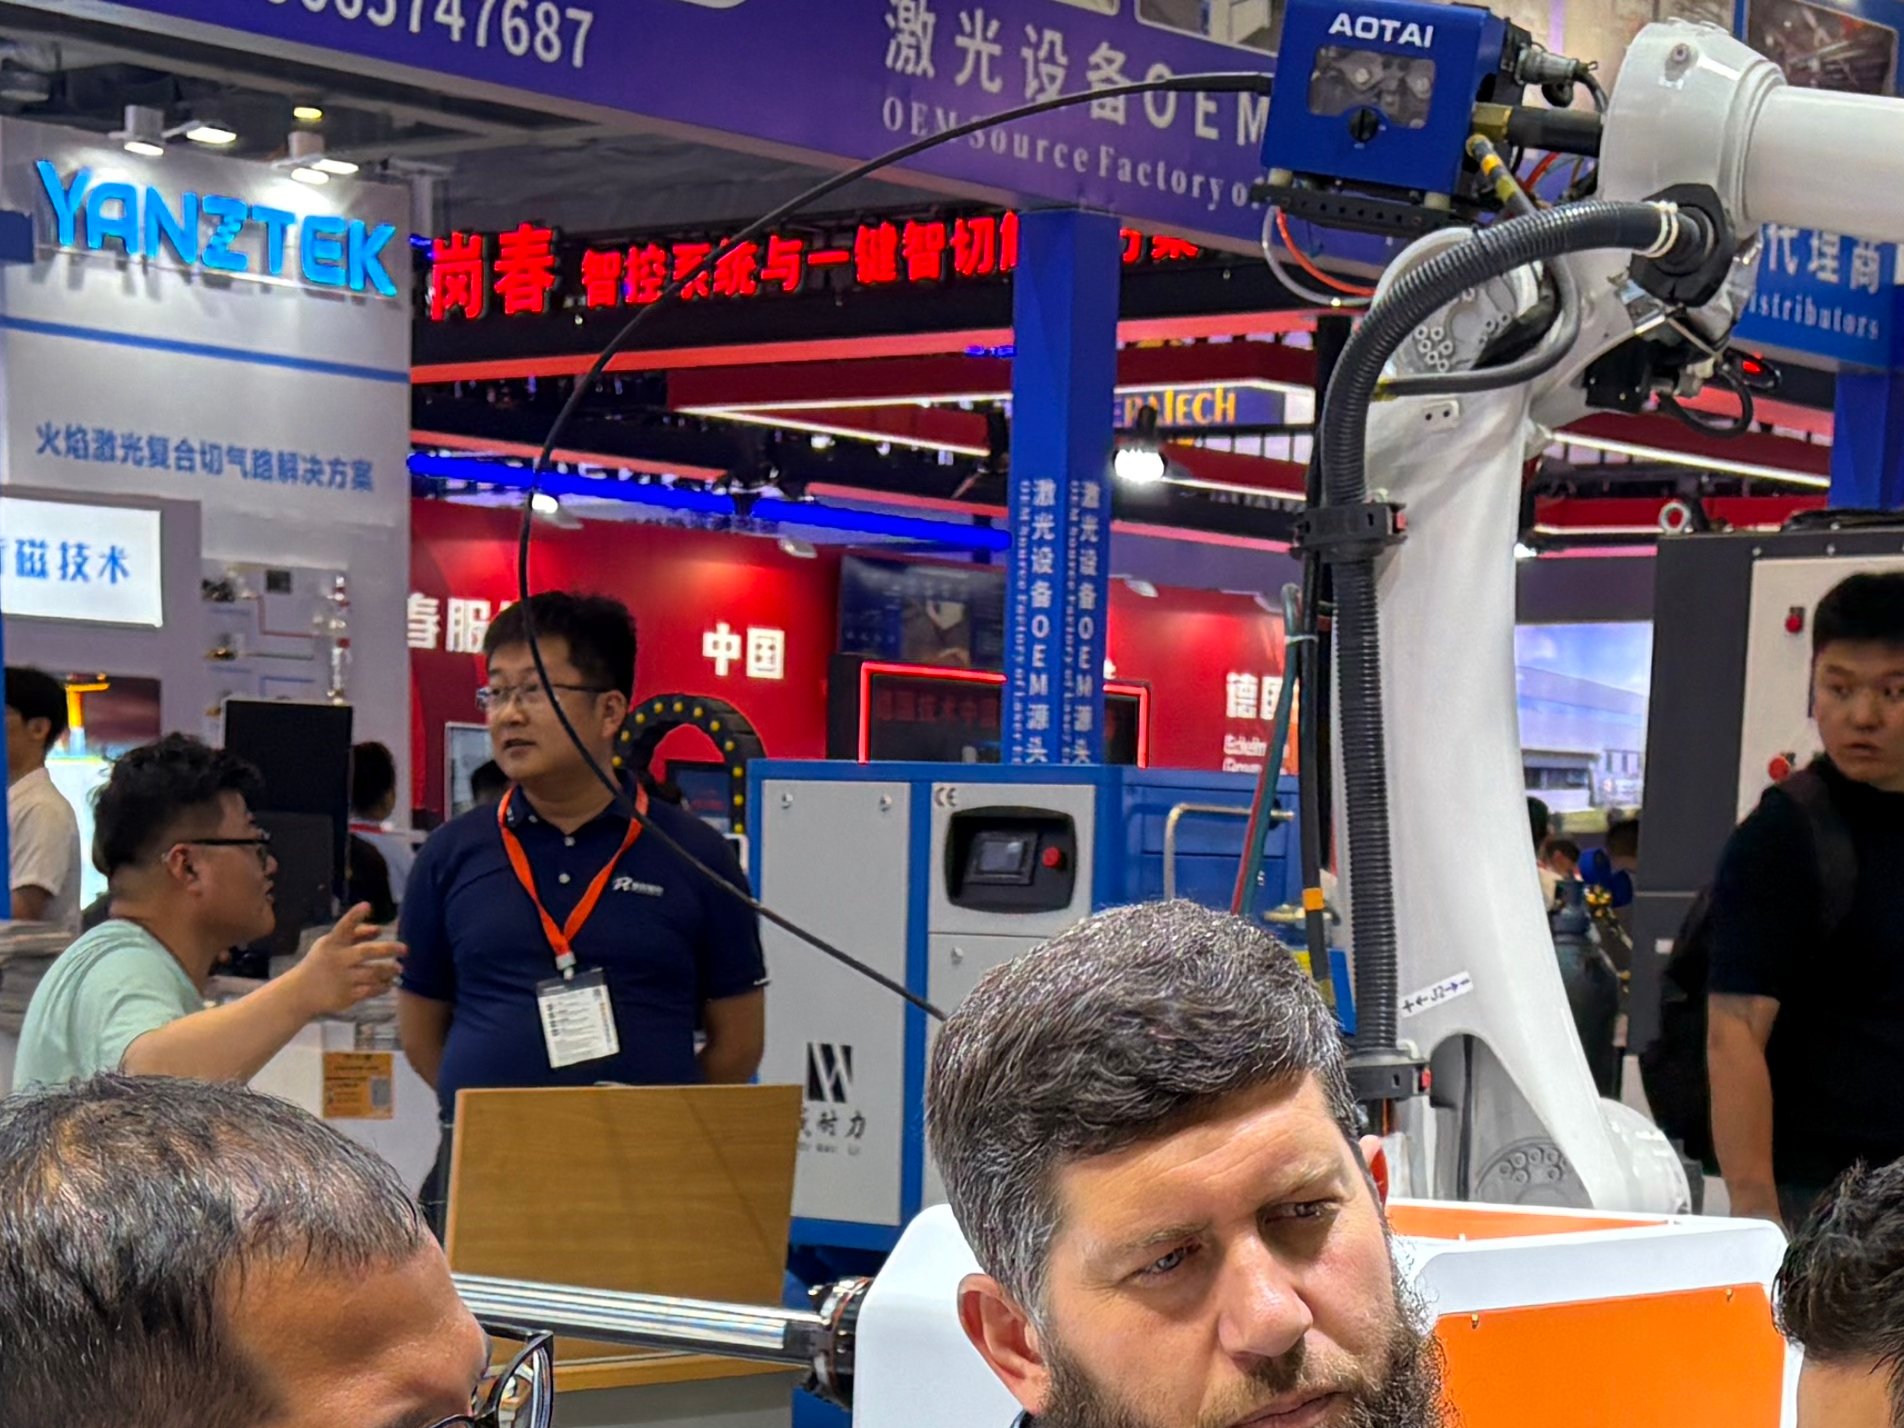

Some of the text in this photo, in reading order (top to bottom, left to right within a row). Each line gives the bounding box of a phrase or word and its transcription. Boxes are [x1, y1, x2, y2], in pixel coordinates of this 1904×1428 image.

[1328, 14, 1434, 48] AOTAI
[968, 115, 1089, 174] Source
[1098, 145, 1225, 211] Factory
[35, 160, 397, 297] YANZTEK
[702, 622, 785, 680] 中国
